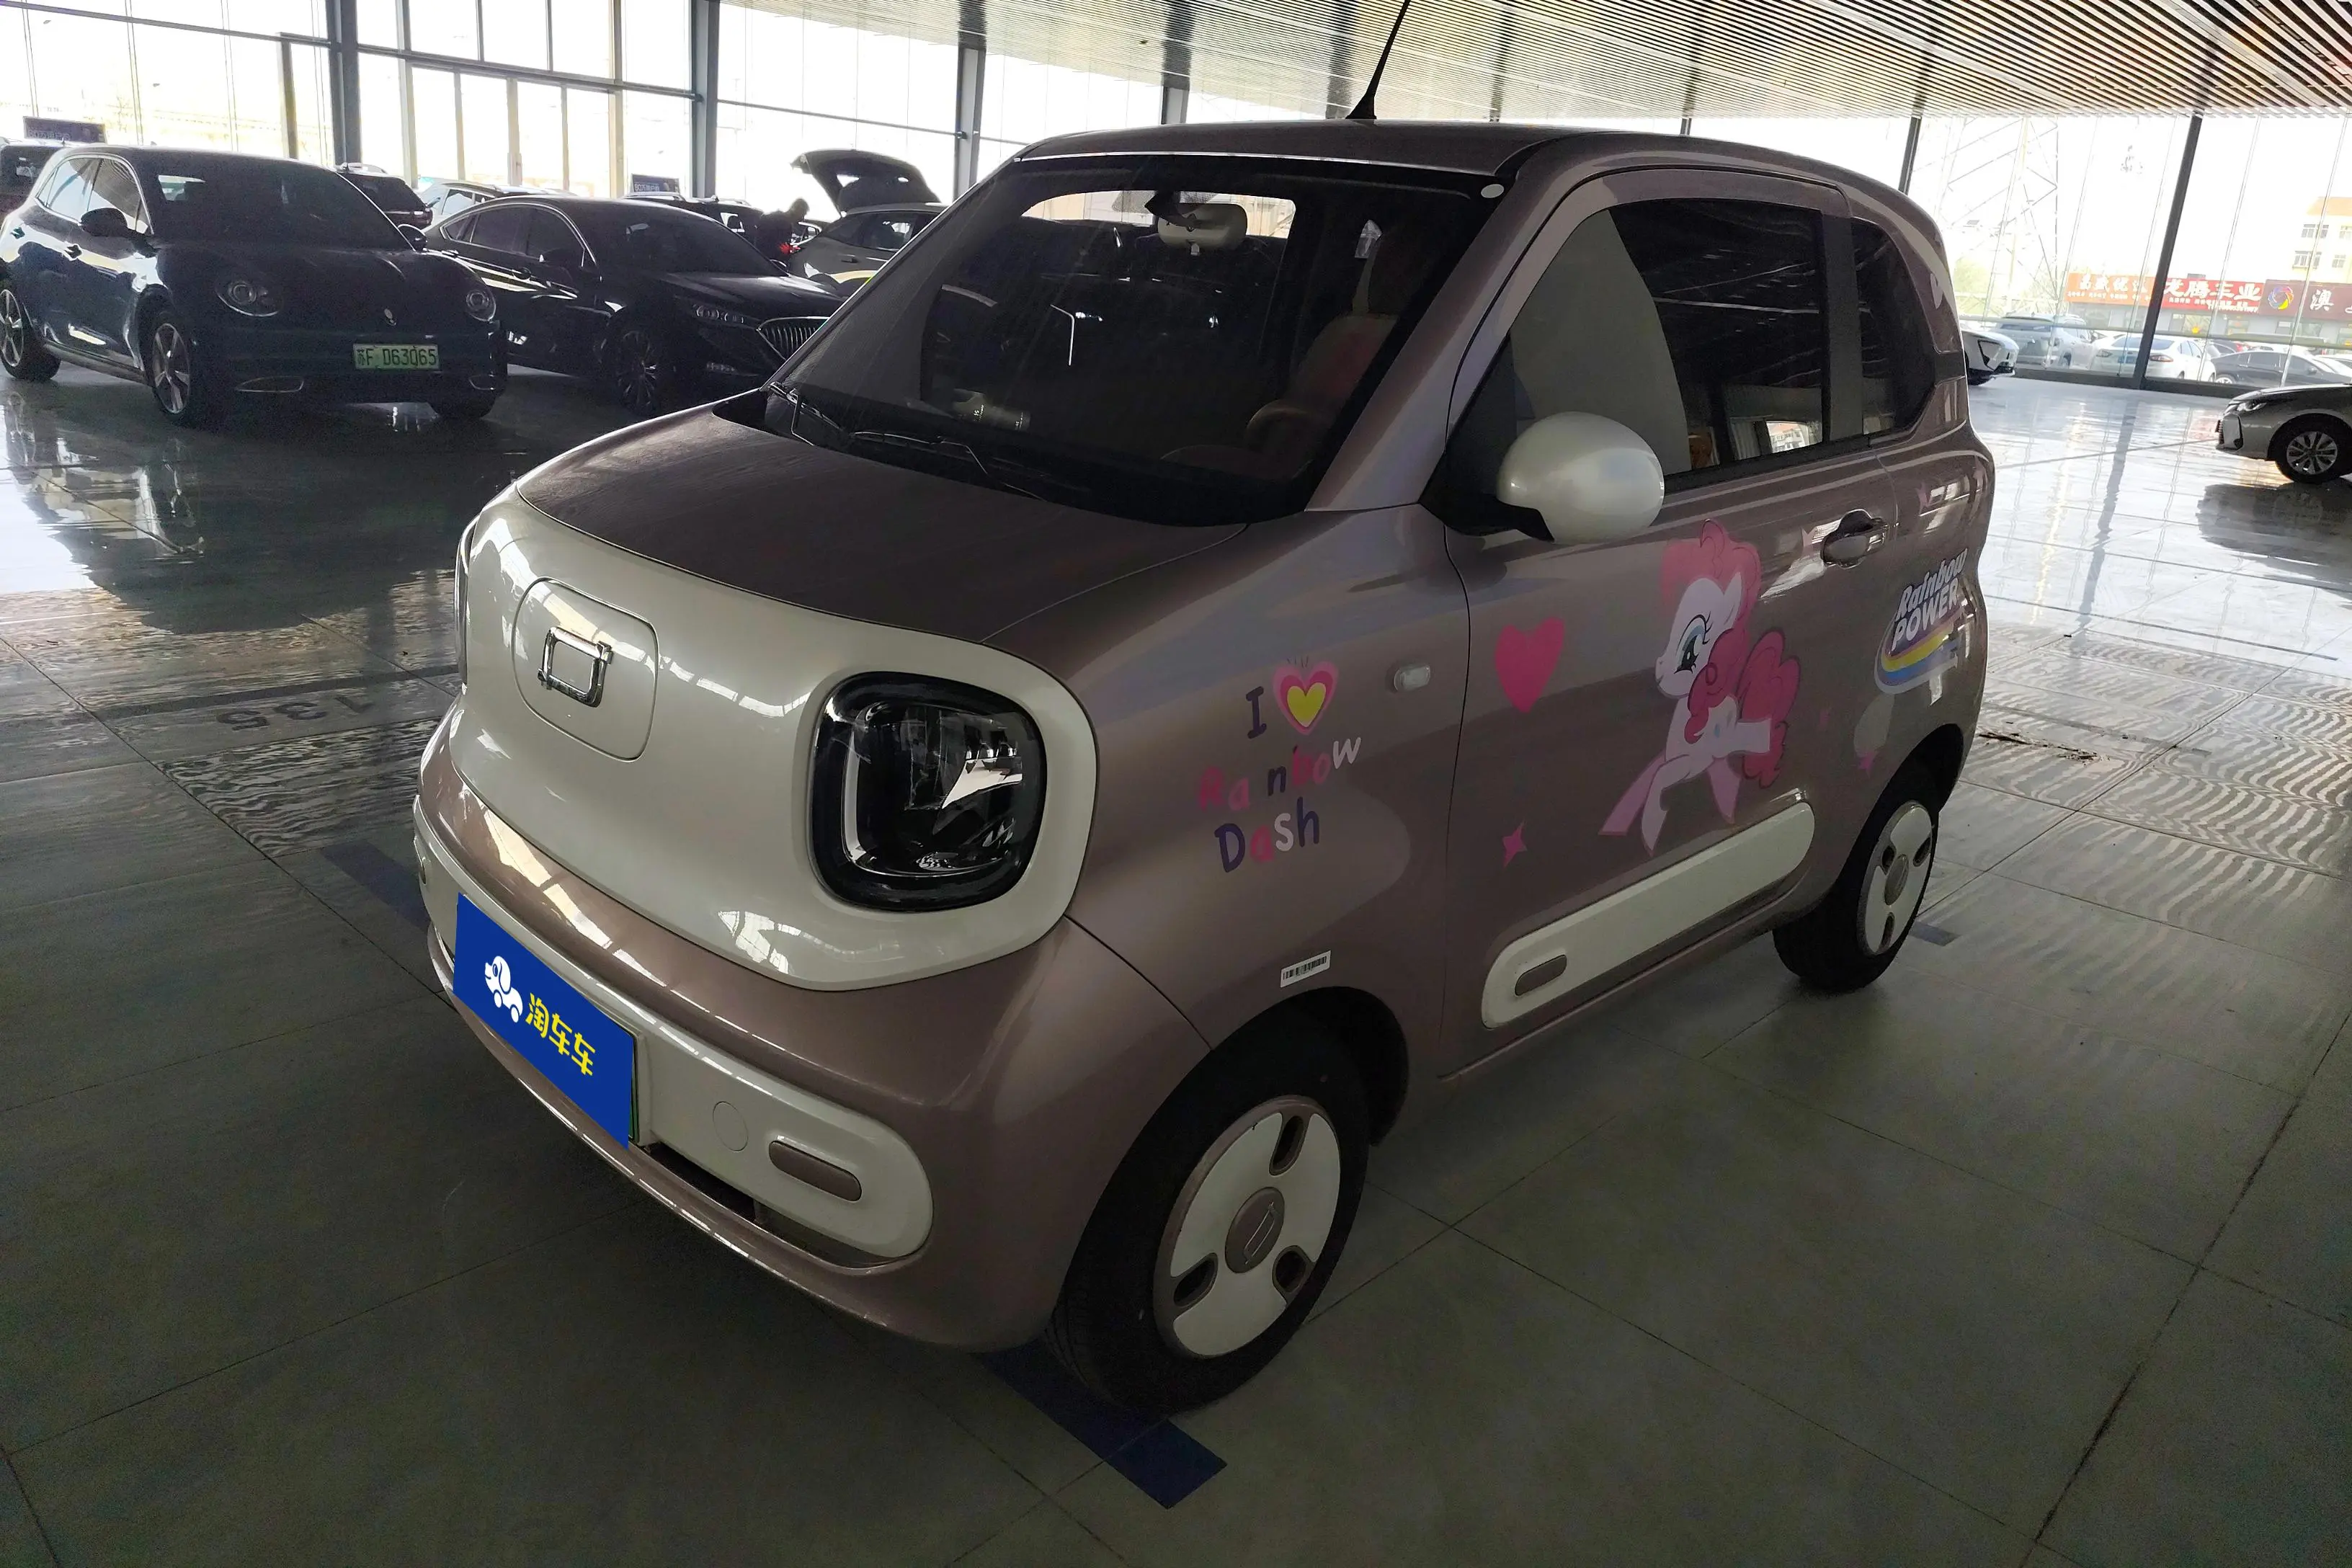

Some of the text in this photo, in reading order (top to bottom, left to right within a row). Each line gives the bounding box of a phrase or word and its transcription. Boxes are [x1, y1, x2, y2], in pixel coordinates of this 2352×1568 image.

[2164, 278, 2263, 301] 龙腾车业
[1891, 577, 1959, 651] POWER
[1895, 548, 1968, 621] Rainbow
[1246, 686, 1267, 739] I
[1198, 736, 1361, 812] Ranbow
[1214, 796, 1319, 873] Dash
